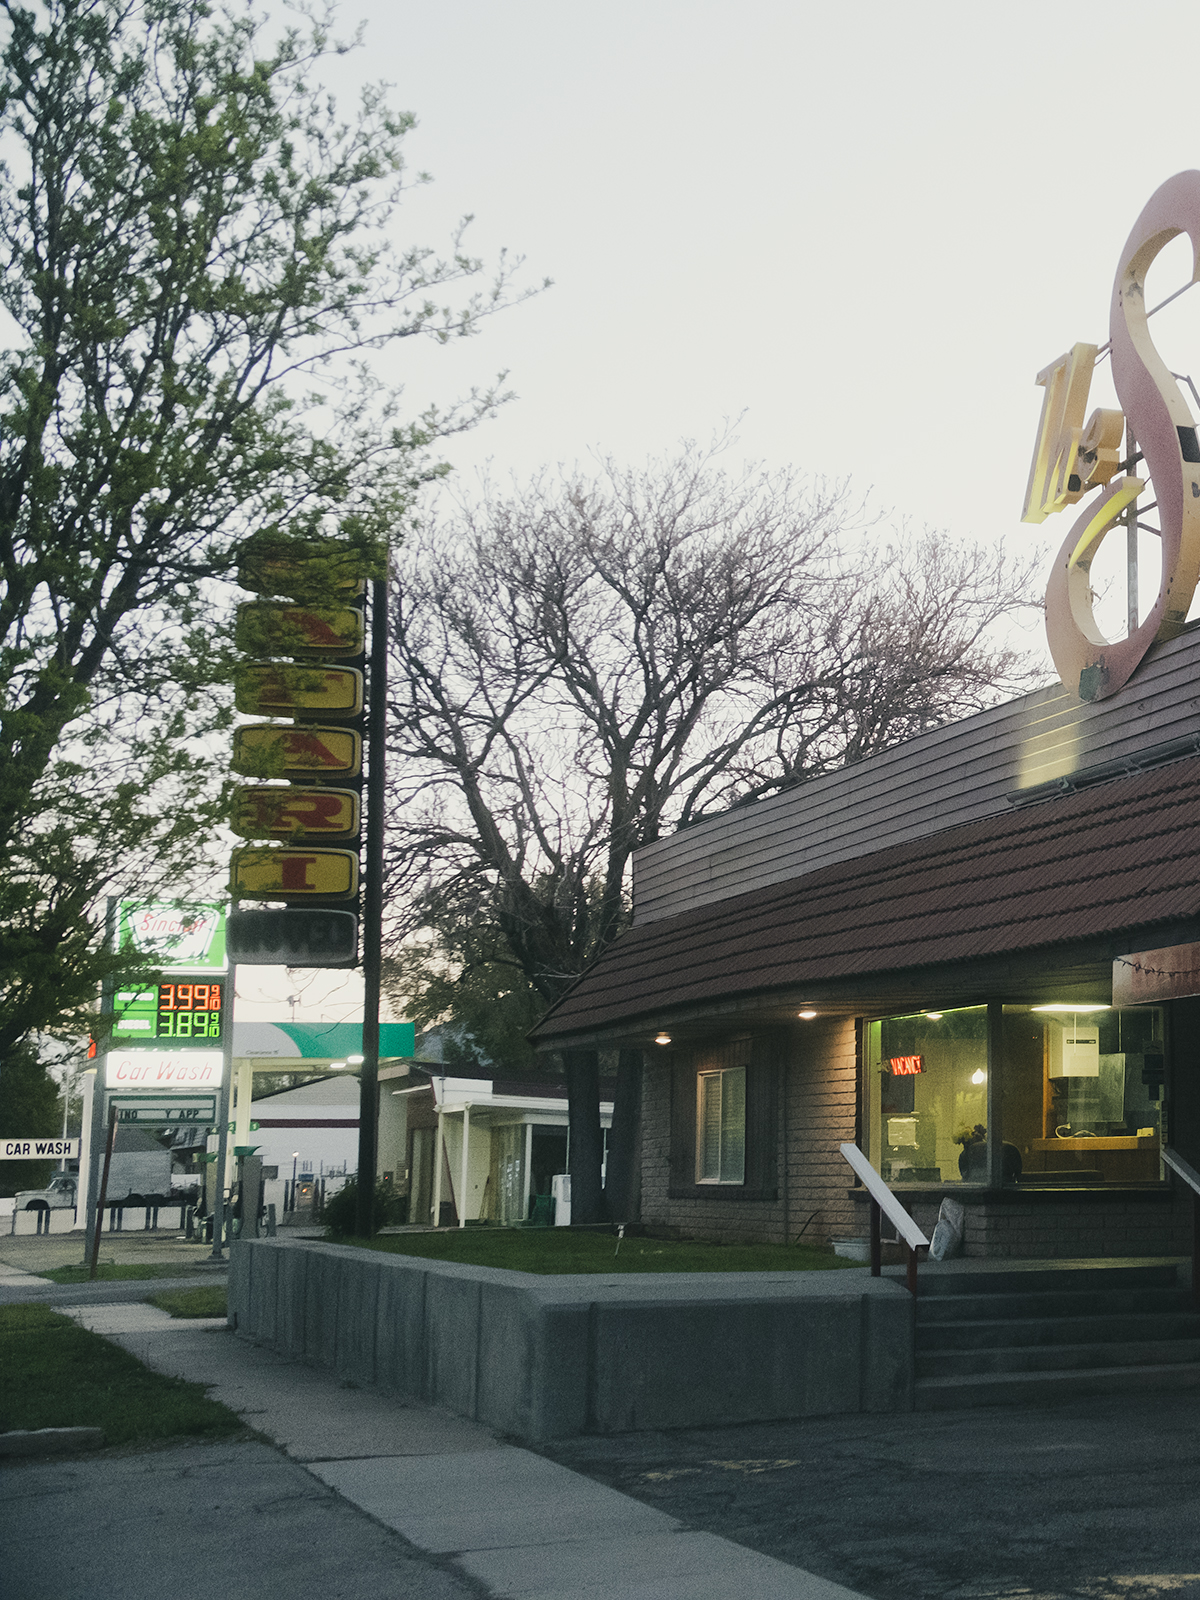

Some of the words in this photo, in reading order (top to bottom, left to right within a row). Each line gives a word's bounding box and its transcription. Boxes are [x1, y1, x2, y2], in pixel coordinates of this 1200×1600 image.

[159, 984, 210, 1011] 3.99
[158, 1011, 209, 1038] 3.89
[116, 1060, 152, 1081] Car
[156, 1060, 213, 1081] Wash
[6, 1142, 31, 1156] CAR
[35, 1141, 71, 1155] WASH
